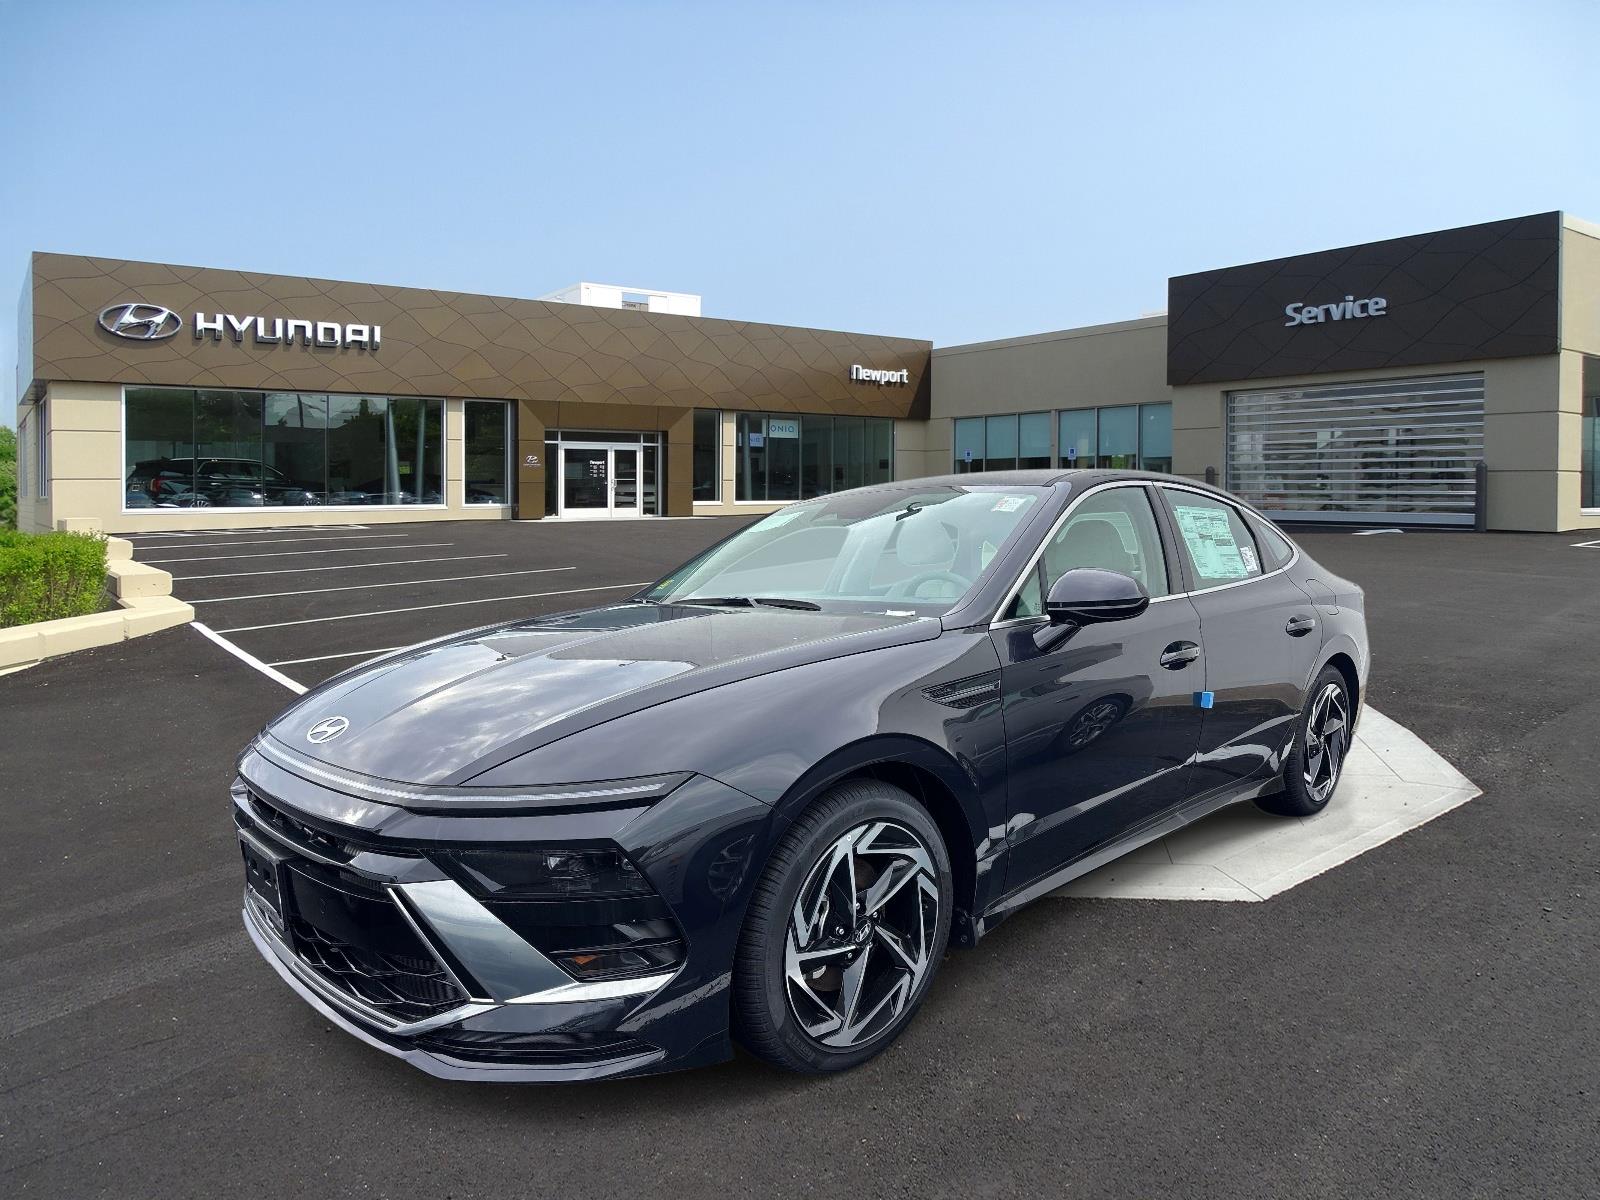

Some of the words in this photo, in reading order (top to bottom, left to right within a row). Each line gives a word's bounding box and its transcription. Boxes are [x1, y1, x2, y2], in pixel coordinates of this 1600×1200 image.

[1284, 295, 1387, 327] Service
[195, 312, 381, 351] HYUNDAI
[850, 364, 909, 385] Newport
